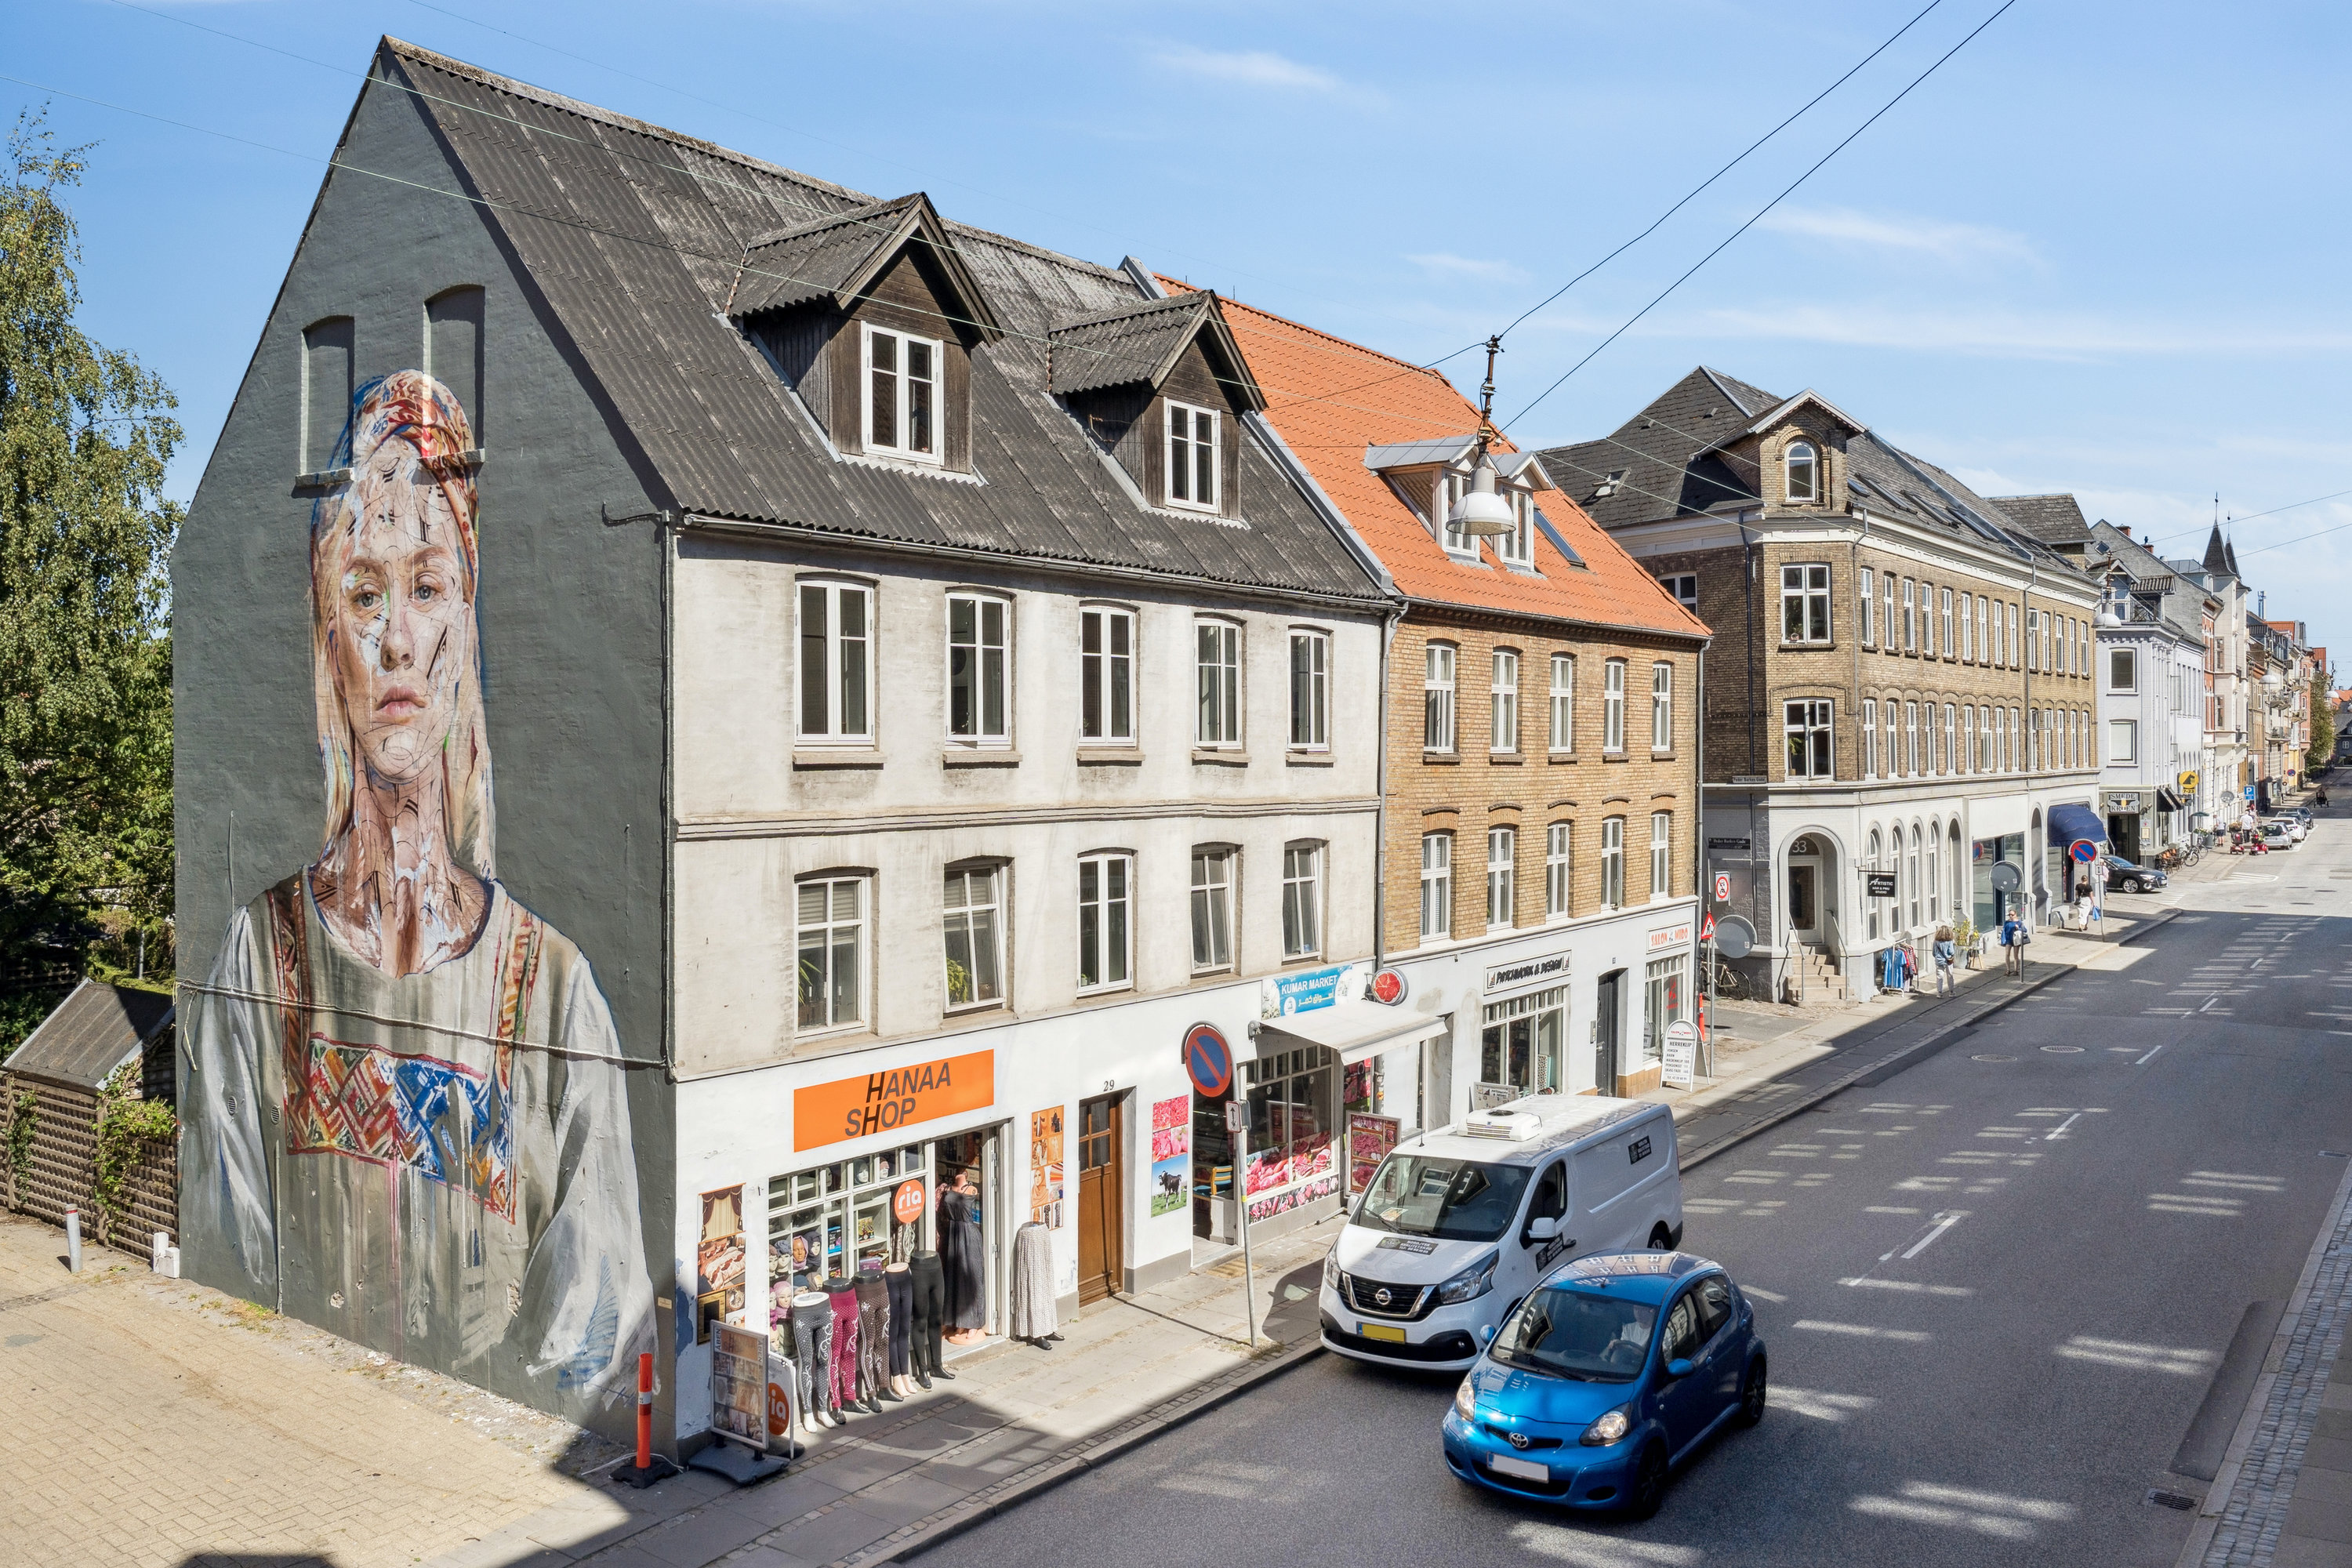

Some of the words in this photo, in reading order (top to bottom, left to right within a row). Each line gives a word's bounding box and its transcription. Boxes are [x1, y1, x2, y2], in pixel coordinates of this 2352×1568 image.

[1792, 840, 1807, 853] 33
[1650, 932, 1668, 947] SALON
[1675, 927, 1688, 941] MIDO
[1281, 980, 1308, 994] KUMAR
[1308, 975, 1338, 989] MARKET
[866, 1062, 951, 1103] HANAA
[1103, 1079, 1115, 1092] 29
[844, 1097, 916, 1137] SHOP
[898, 1185, 922, 1210] ria
[768, 1388, 786, 1421] ia
